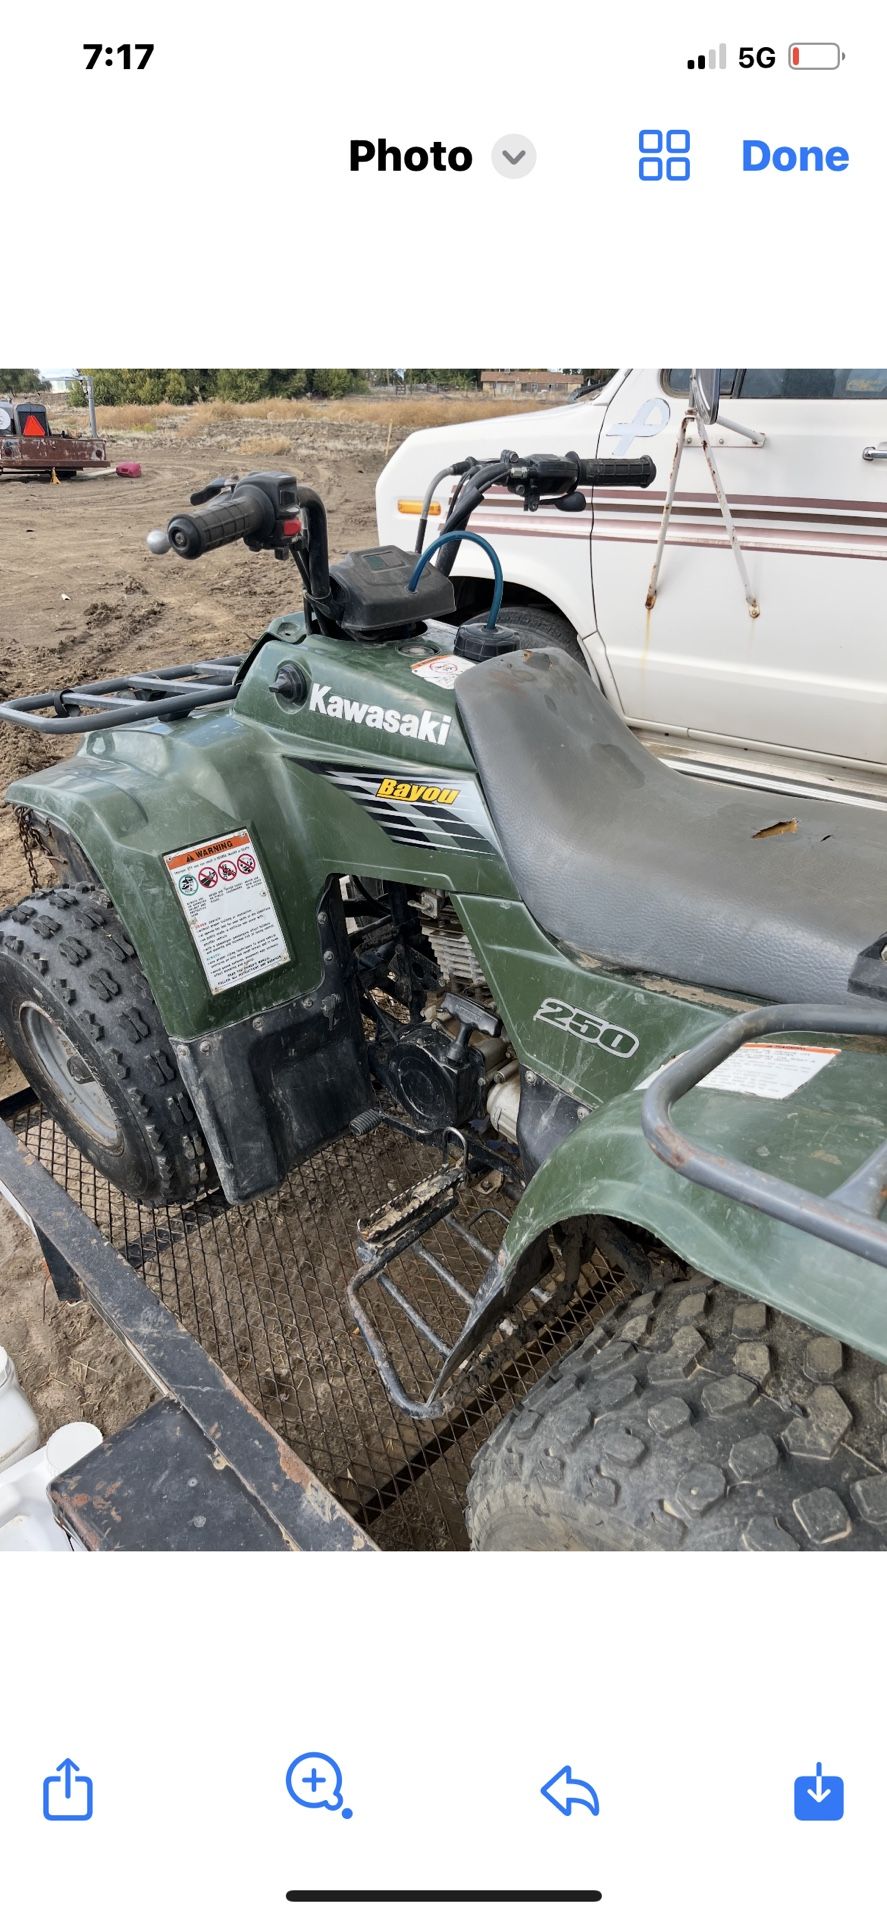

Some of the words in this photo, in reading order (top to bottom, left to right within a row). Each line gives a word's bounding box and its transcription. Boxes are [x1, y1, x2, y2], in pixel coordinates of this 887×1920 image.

[309, 683, 452, 745] Kawasaki
[376, 778, 460, 805] Bayou
[195, 840, 234, 858] WARNING
[533, 998, 640, 1058] 250
